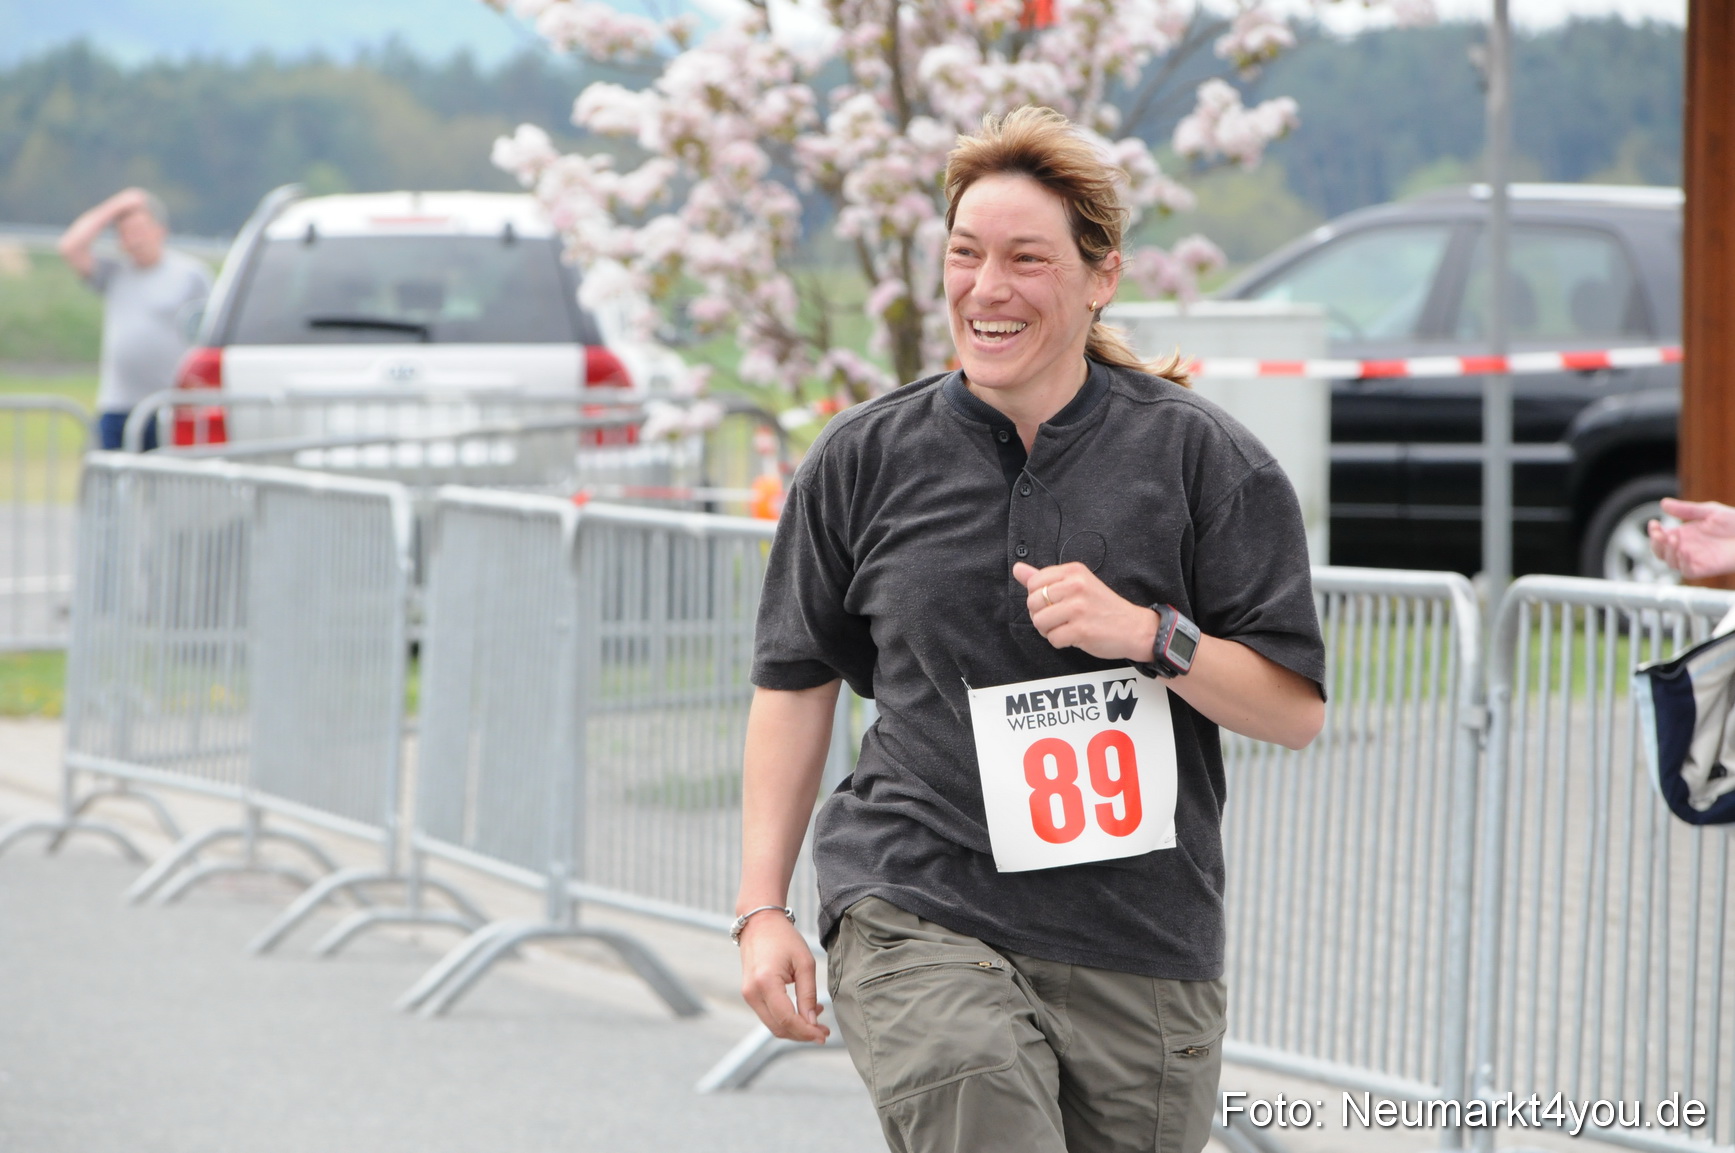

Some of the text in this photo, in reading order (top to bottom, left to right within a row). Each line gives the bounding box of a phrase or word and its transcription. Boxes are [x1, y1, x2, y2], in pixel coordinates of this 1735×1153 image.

[1005, 683, 1098, 716] MEYER
[1007, 705, 1100, 731] WERBUNG
[1023, 729, 1143, 844] 89
